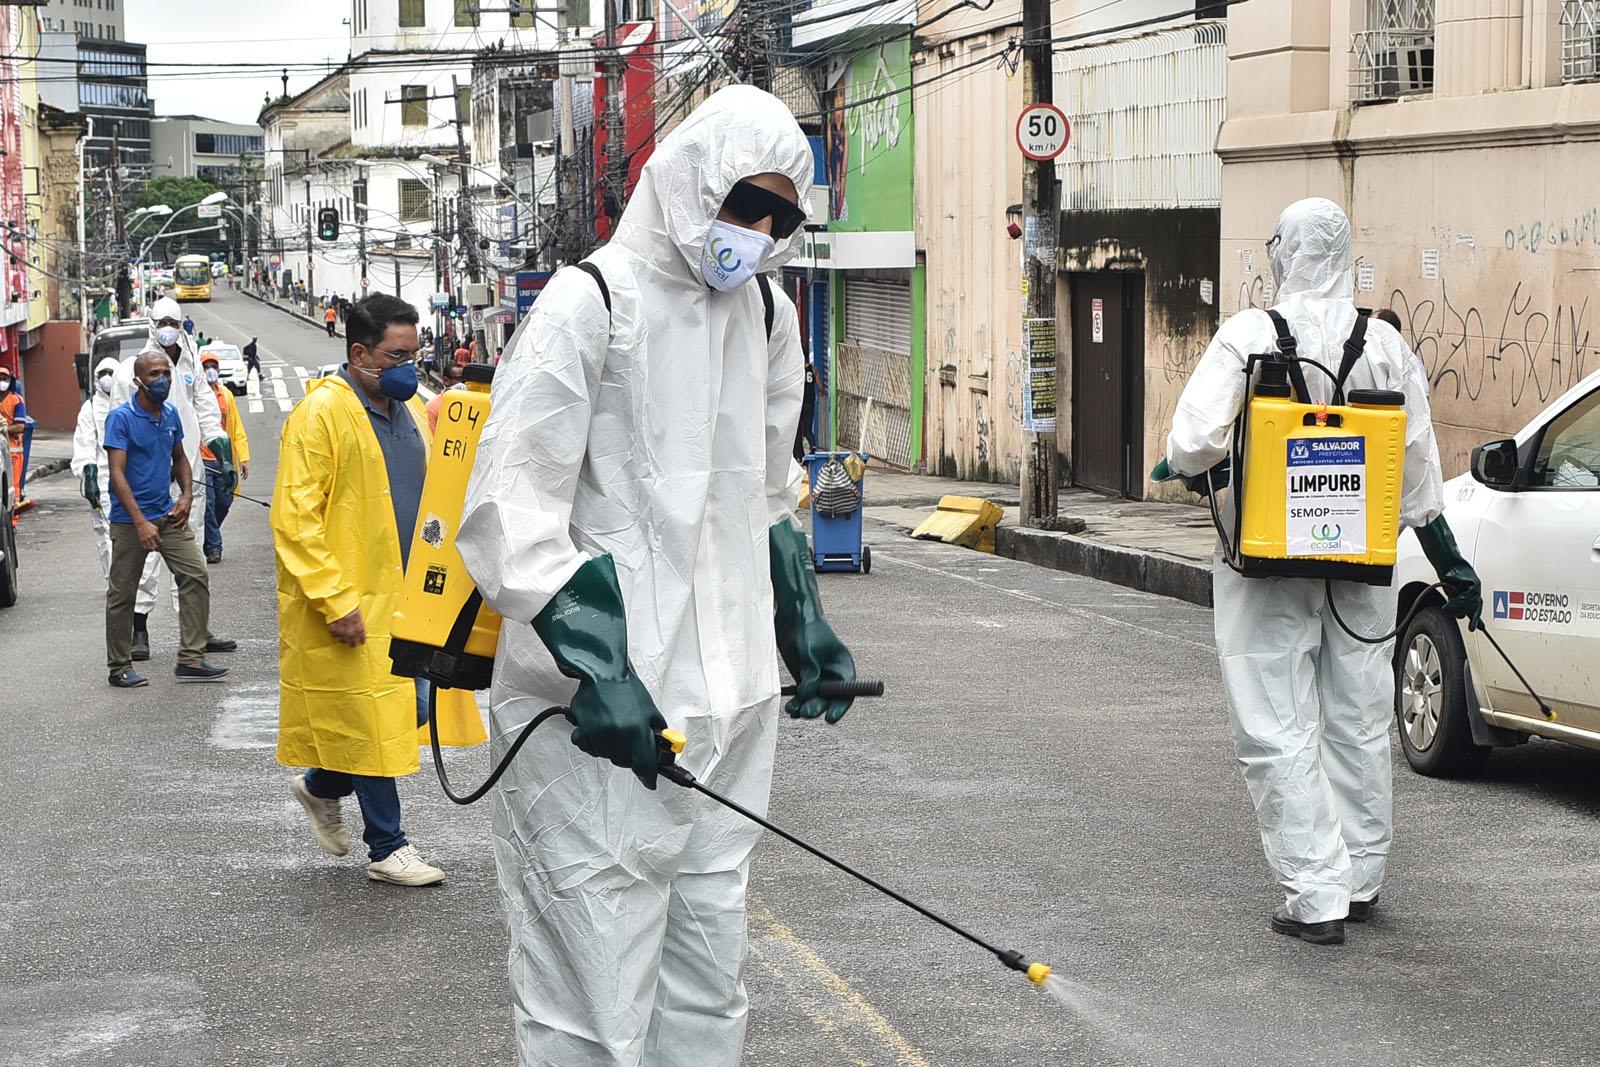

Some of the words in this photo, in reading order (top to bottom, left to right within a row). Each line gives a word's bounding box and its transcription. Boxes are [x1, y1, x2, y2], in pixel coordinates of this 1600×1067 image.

[1029, 115, 1057, 137] 50
[1028, 143, 1056, 151] km/h
[806, 371, 813, 383] 6
[448, 401, 480, 431] 04
[1312, 441, 1360, 451] SALVADOR
[1291, 474, 1361, 493] LIMPURB
[1290, 508, 1330, 518] SEMOP
[1311, 540, 1342, 549] ecosal
[1526, 592, 1569, 608] GOVERNO
[1524, 608, 1538, 621] DO
[1539, 608, 1572, 624] ESTADO
